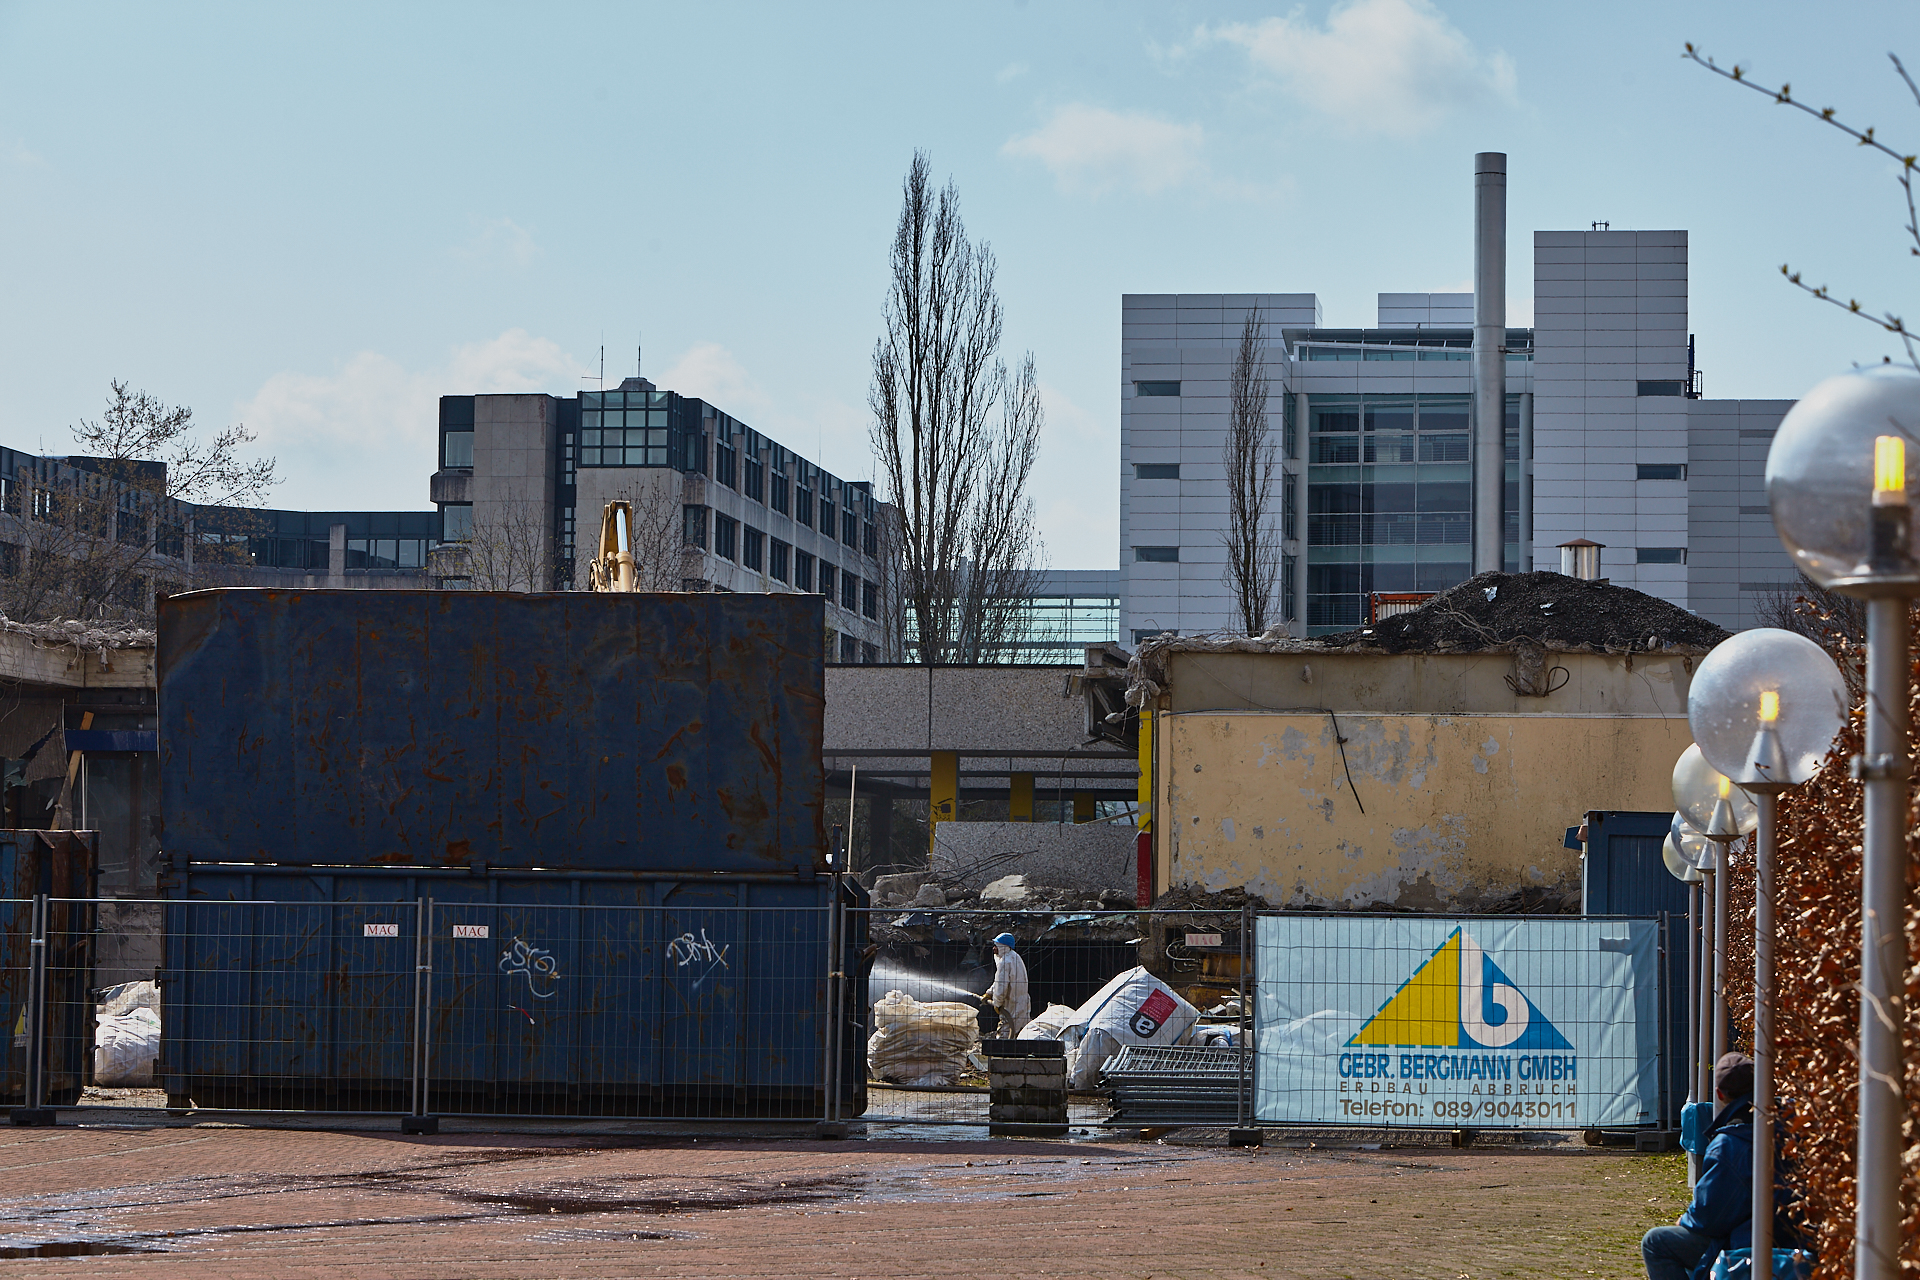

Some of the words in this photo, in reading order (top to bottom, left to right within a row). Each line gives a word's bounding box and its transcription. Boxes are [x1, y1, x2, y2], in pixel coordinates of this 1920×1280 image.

[367, 925, 396, 936] MAC
[456, 926, 486, 937] MAC
[1187, 934, 1218, 946] MAC
[1339, 1053, 1395, 1079] GEBR.
[1400, 1053, 1511, 1081] BERGMANN
[1518, 1055, 1577, 1081] GMBH
[1340, 1081, 1428, 1094] ERDBAU
[1472, 1083, 1577, 1096] ABBRUCH
[1340, 1099, 1425, 1117] Telefon:
[1433, 1101, 1576, 1119] 089/9043011
